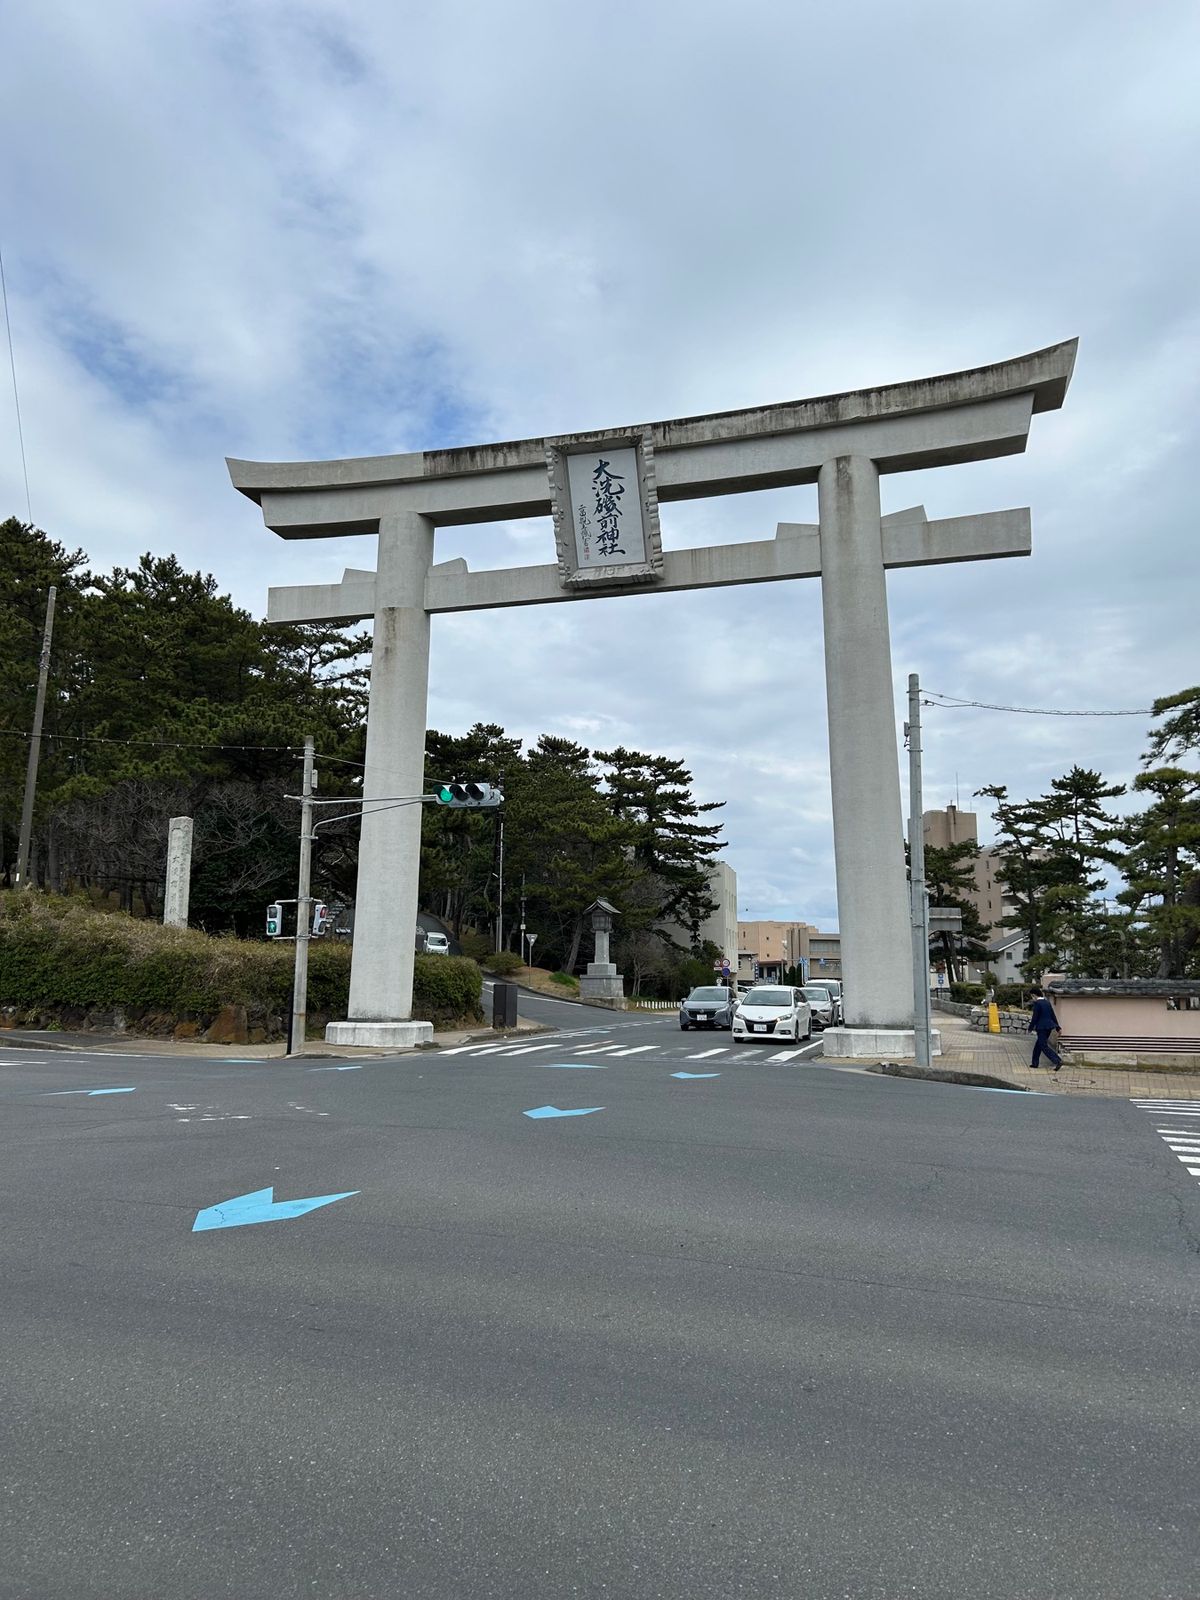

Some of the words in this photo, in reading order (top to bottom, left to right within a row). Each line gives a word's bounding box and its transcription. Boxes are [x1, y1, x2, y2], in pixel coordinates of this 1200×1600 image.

[591, 459, 626, 557] 大洗磯前神社
